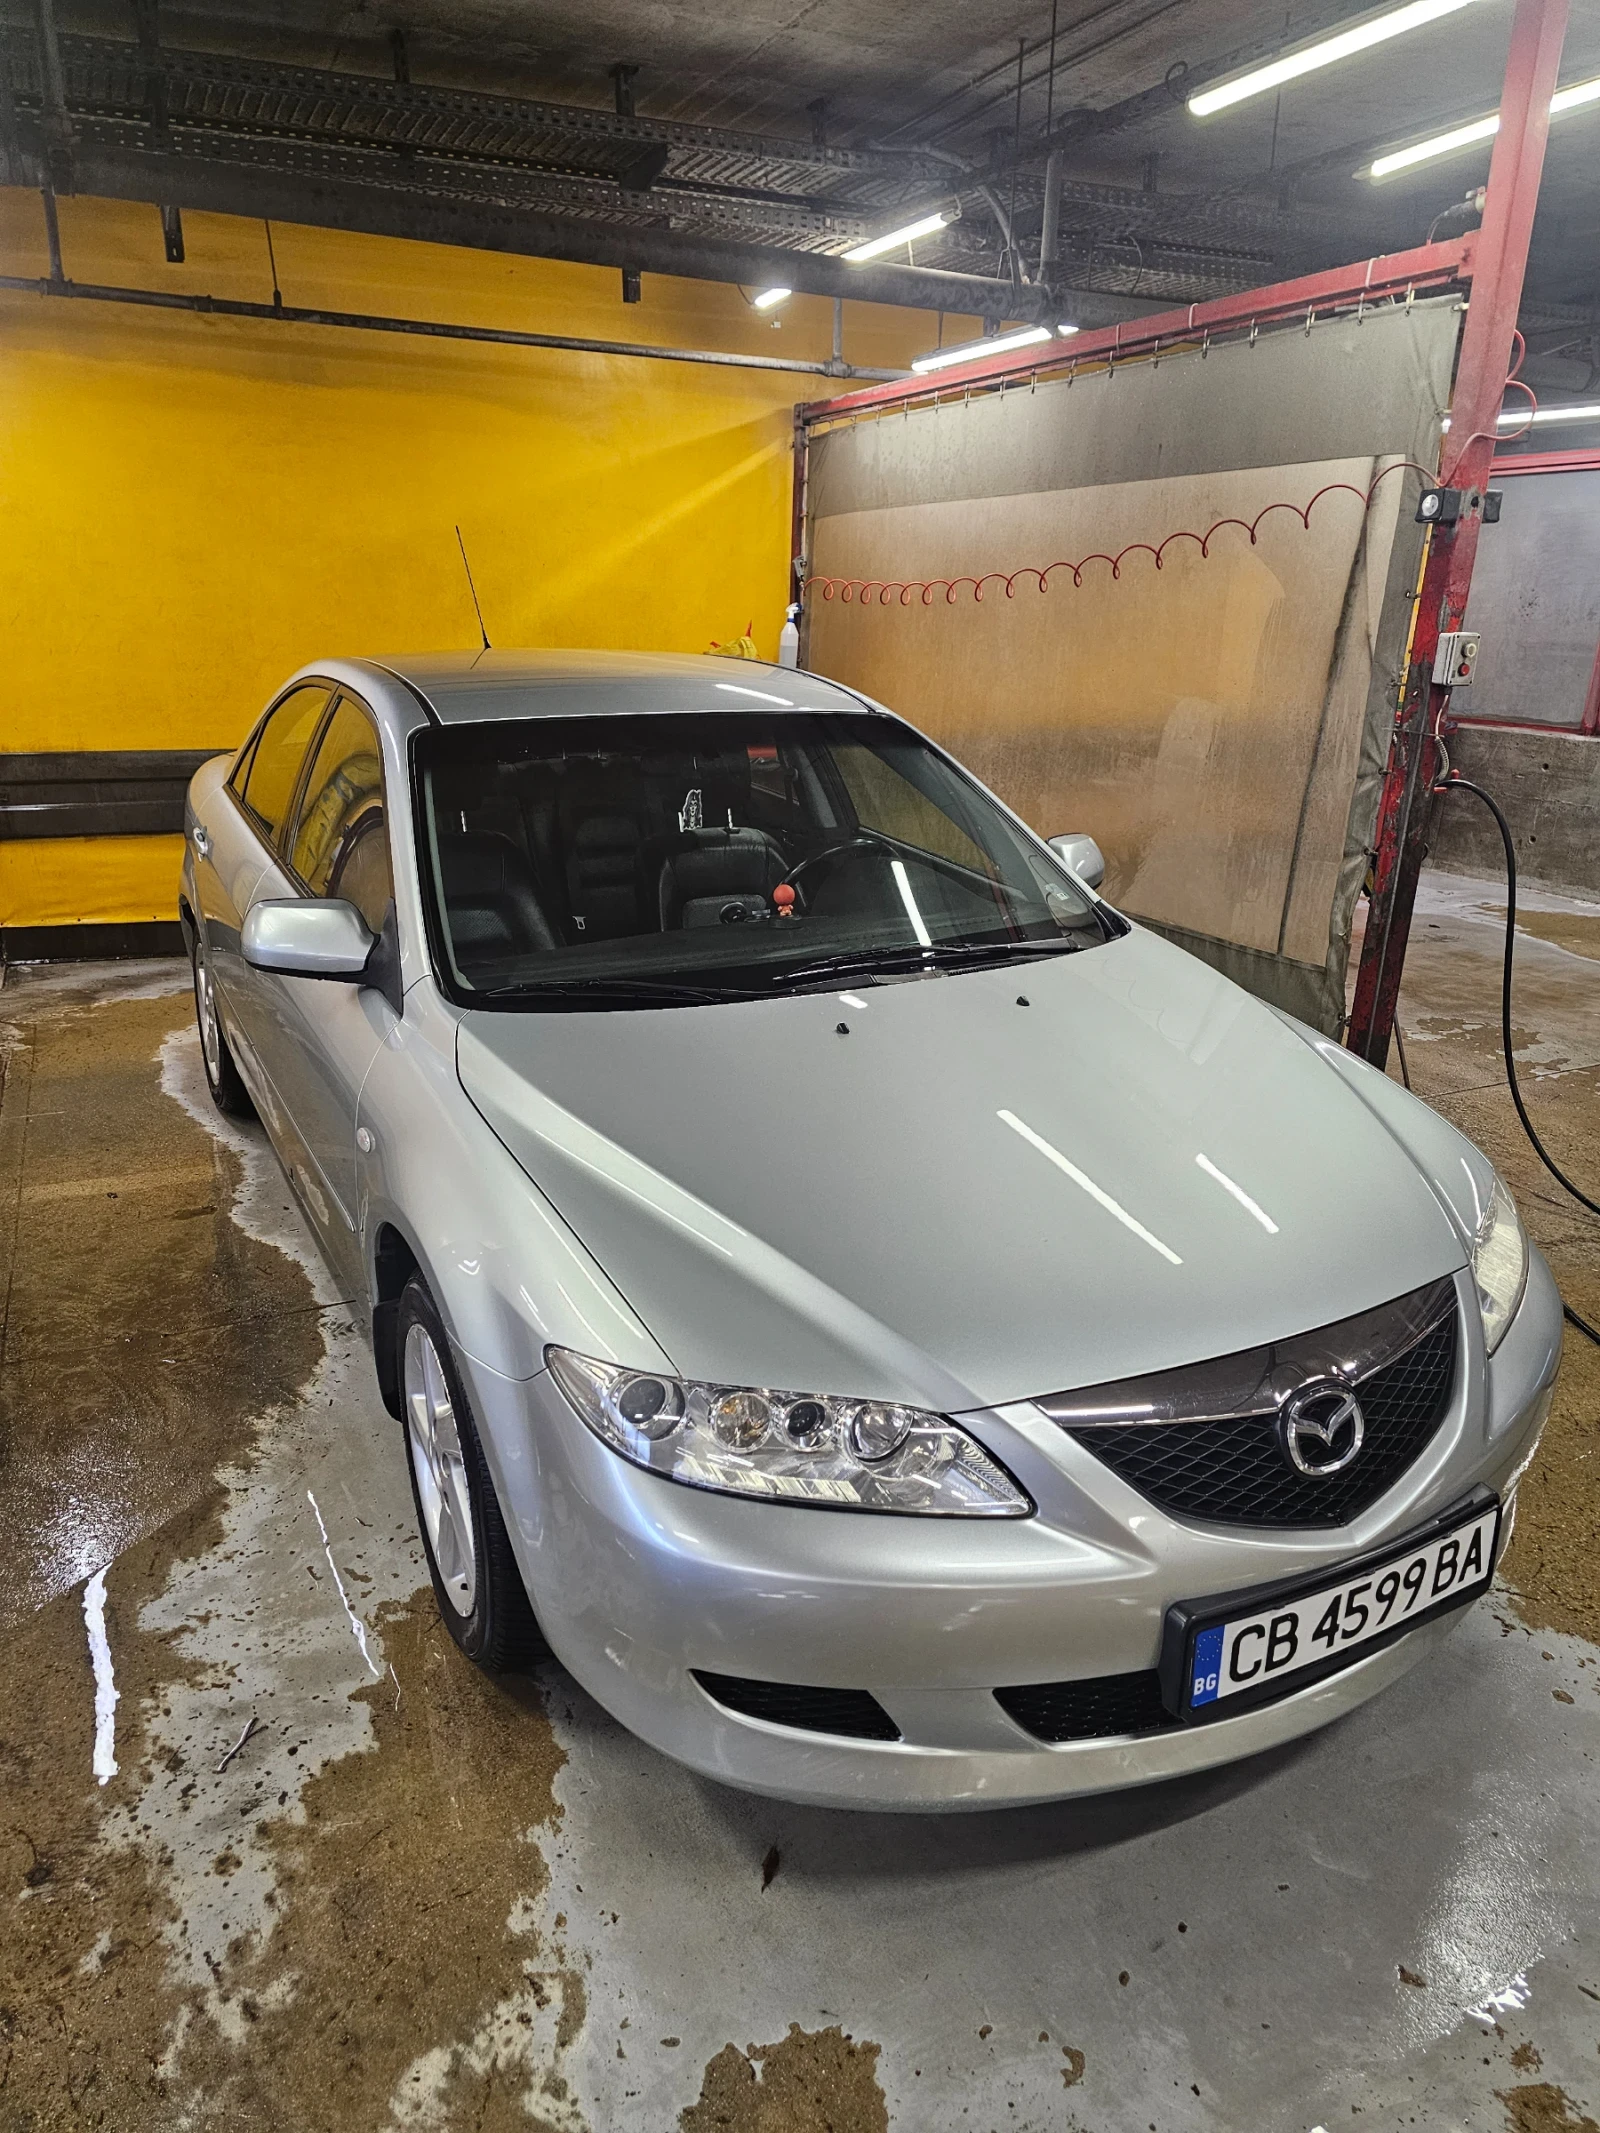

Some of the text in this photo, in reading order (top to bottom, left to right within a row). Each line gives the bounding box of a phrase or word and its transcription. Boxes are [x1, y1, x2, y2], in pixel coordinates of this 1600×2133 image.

[1229, 1526, 1482, 1683] CB 4599 BA
[1193, 1673, 1217, 1696] BG
